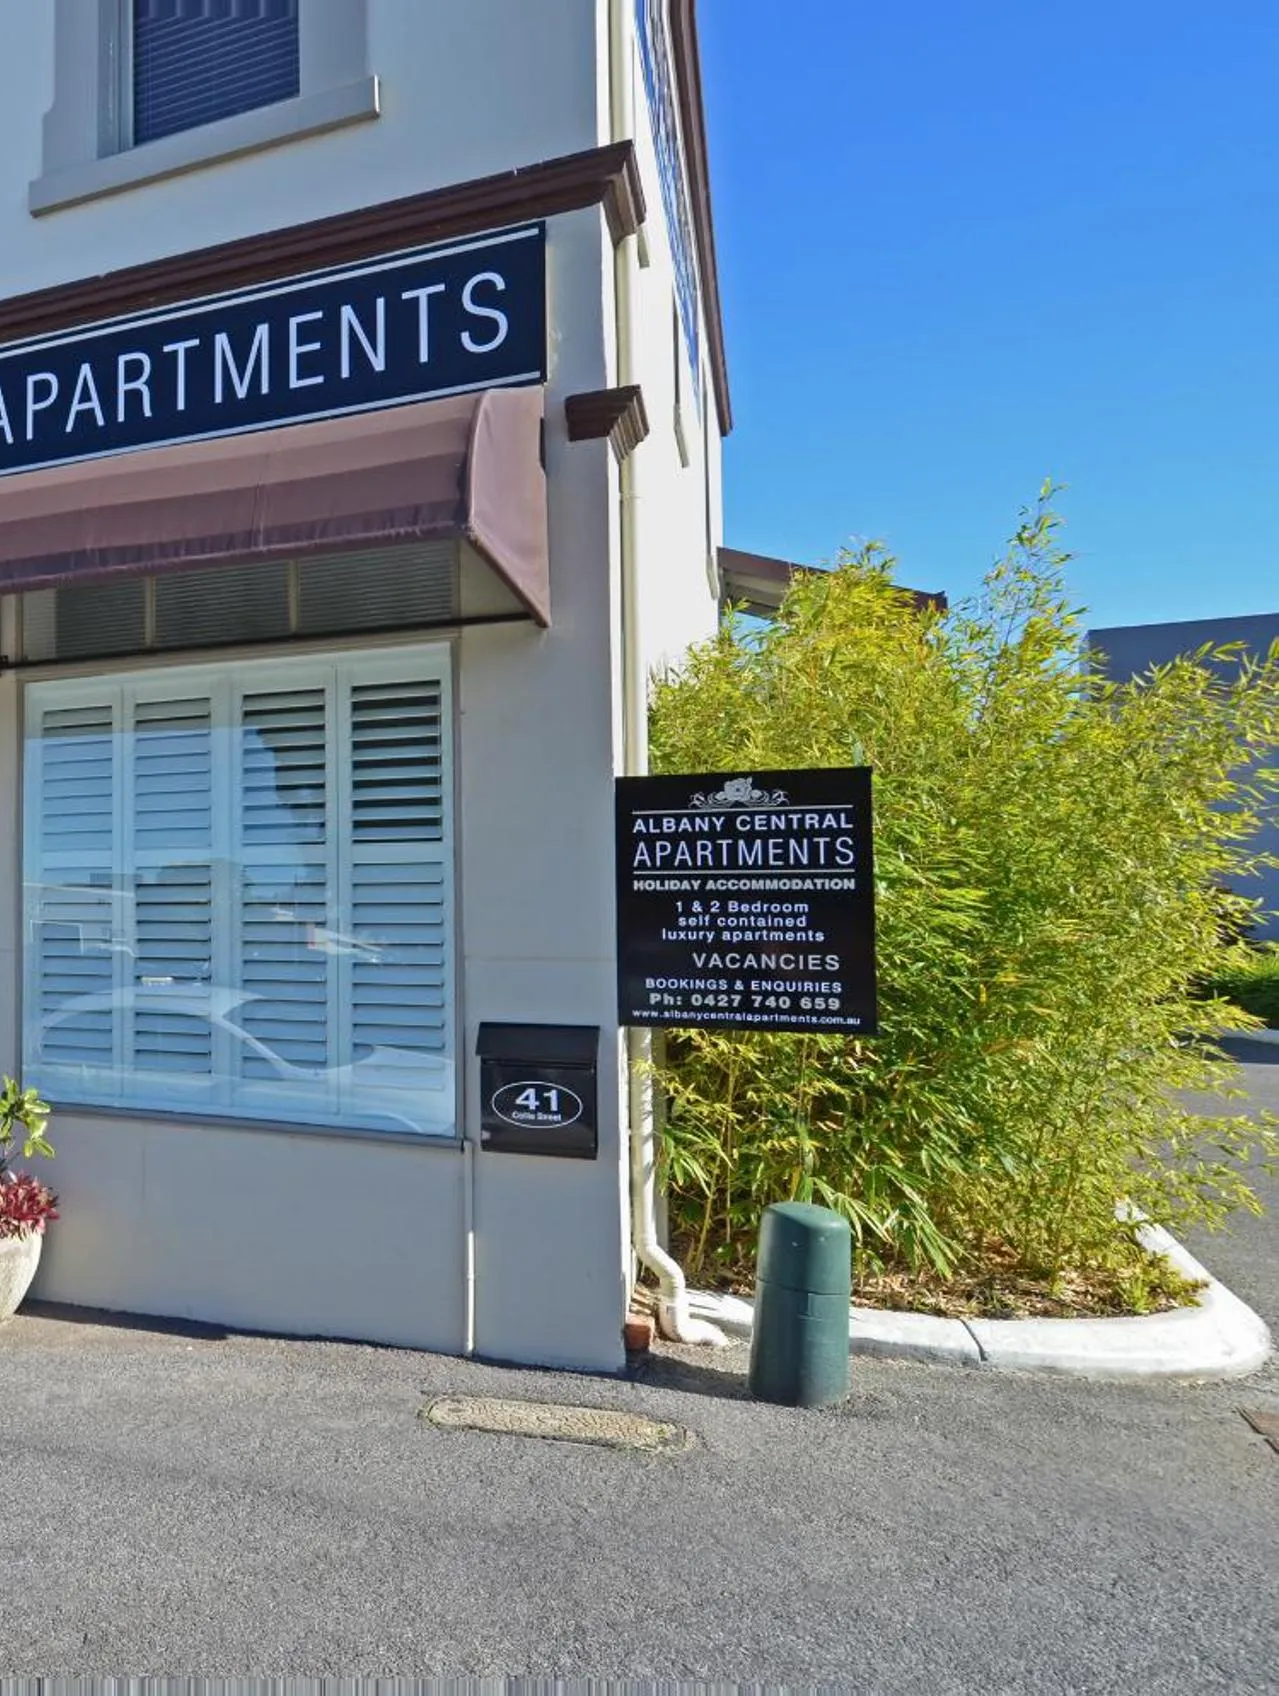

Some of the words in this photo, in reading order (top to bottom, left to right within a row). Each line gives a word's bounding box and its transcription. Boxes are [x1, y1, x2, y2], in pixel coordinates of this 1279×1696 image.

[632, 816, 726, 834] ALBANY
[735, 813, 854, 832] CENTRAL
[632, 837, 855, 868] APARTMENTS
[633, 879, 701, 891] HOLIDAY
[705, 878, 856, 891] ACCOMMODATION
[676, 901, 683, 913] 1
[691, 901, 704, 913] &
[710, 901, 721, 913] 2
[728, 901, 809, 913] Bedroom
[678, 915, 710, 927] self
[717, 915, 807, 928] contained
[662, 928, 715, 943] luxury
[722, 929, 825, 943] apartments
[692, 952, 840, 971] VACANCIES
[645, 978, 728, 991] BOOKINGS
[734, 979, 744, 991] &
[751, 979, 842, 993] ENQUIRIES
[649, 993, 683, 1006] Ph:
[691, 994, 741, 1007] 0427
[751, 995, 791, 1009] 740
[800, 997, 841, 1011] 659
[632, 1009, 861, 1025] www.albanycentralapartments.com.au
[515, 1088, 559, 1112] 41
